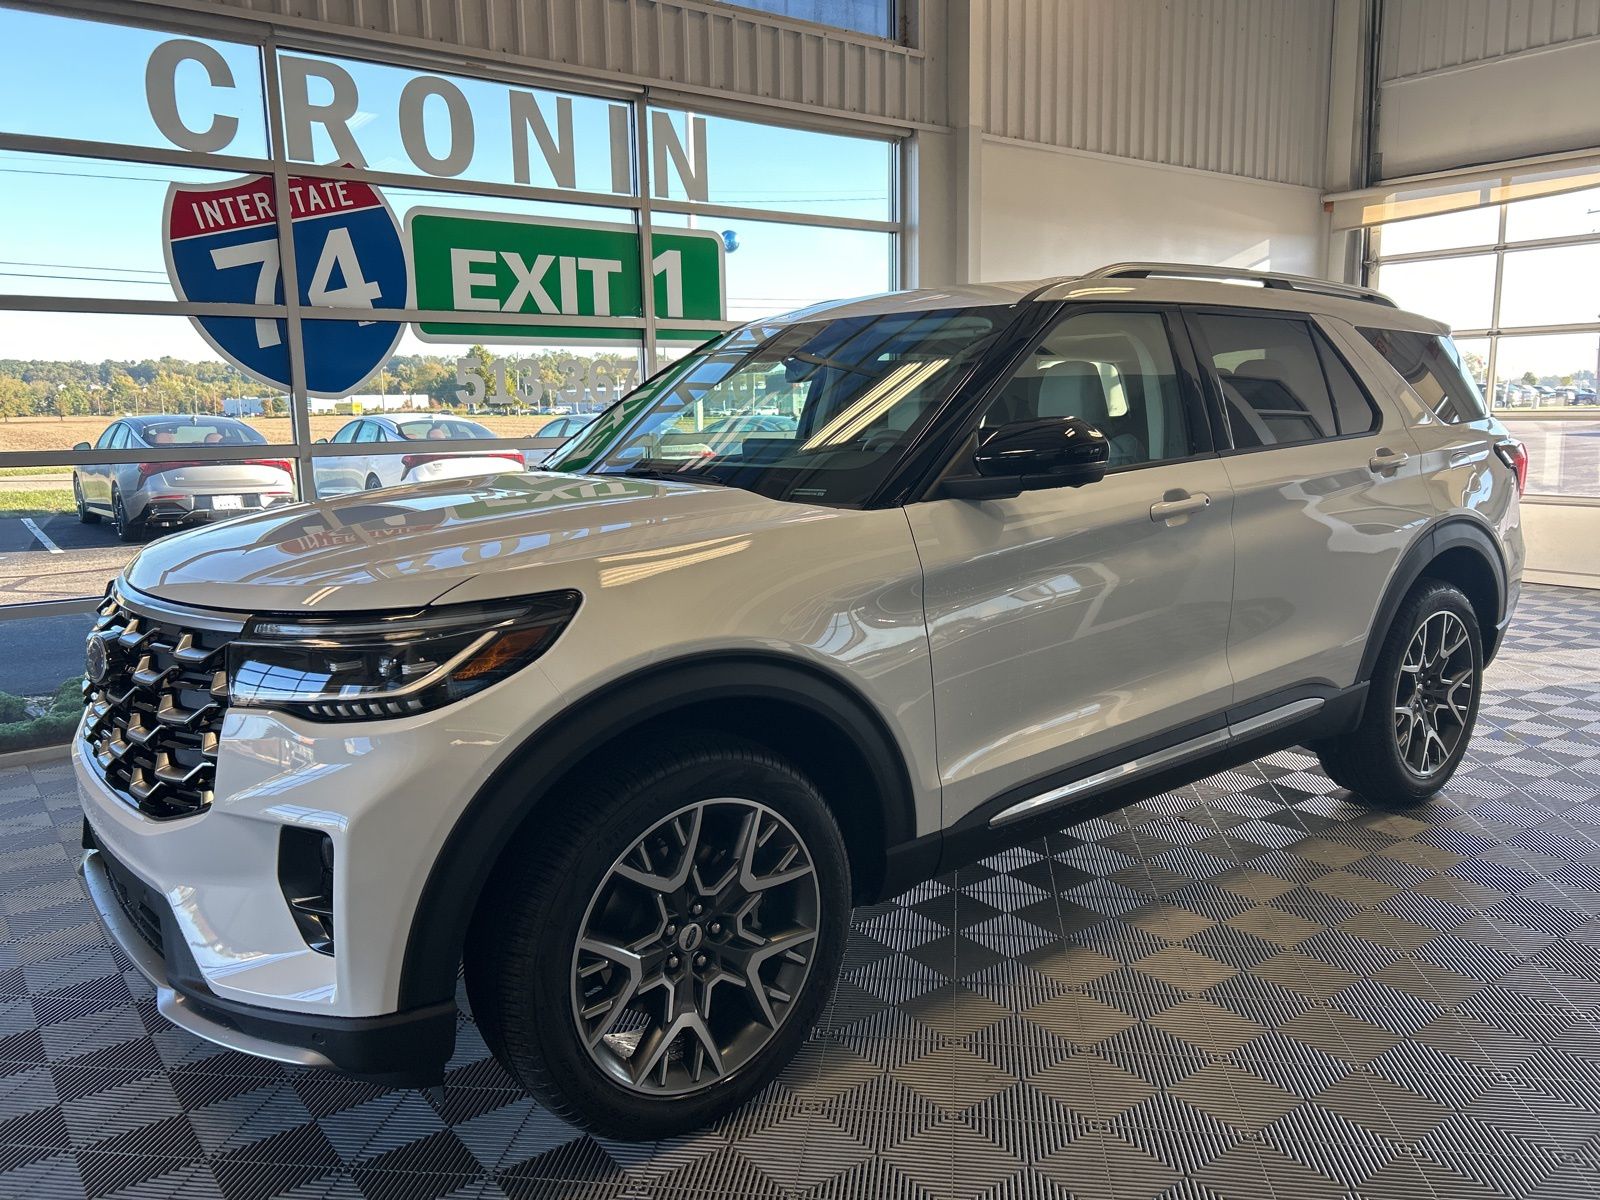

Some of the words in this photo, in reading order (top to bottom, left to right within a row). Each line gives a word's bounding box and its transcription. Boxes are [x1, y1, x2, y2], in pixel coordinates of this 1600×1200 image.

[145, 38, 708, 202] CRONIN
[192, 180, 353, 230] INTERTATE
[209, 227, 383, 349] 74
[450, 248, 622, 317] EXIT
[652, 249, 684, 318] 1
